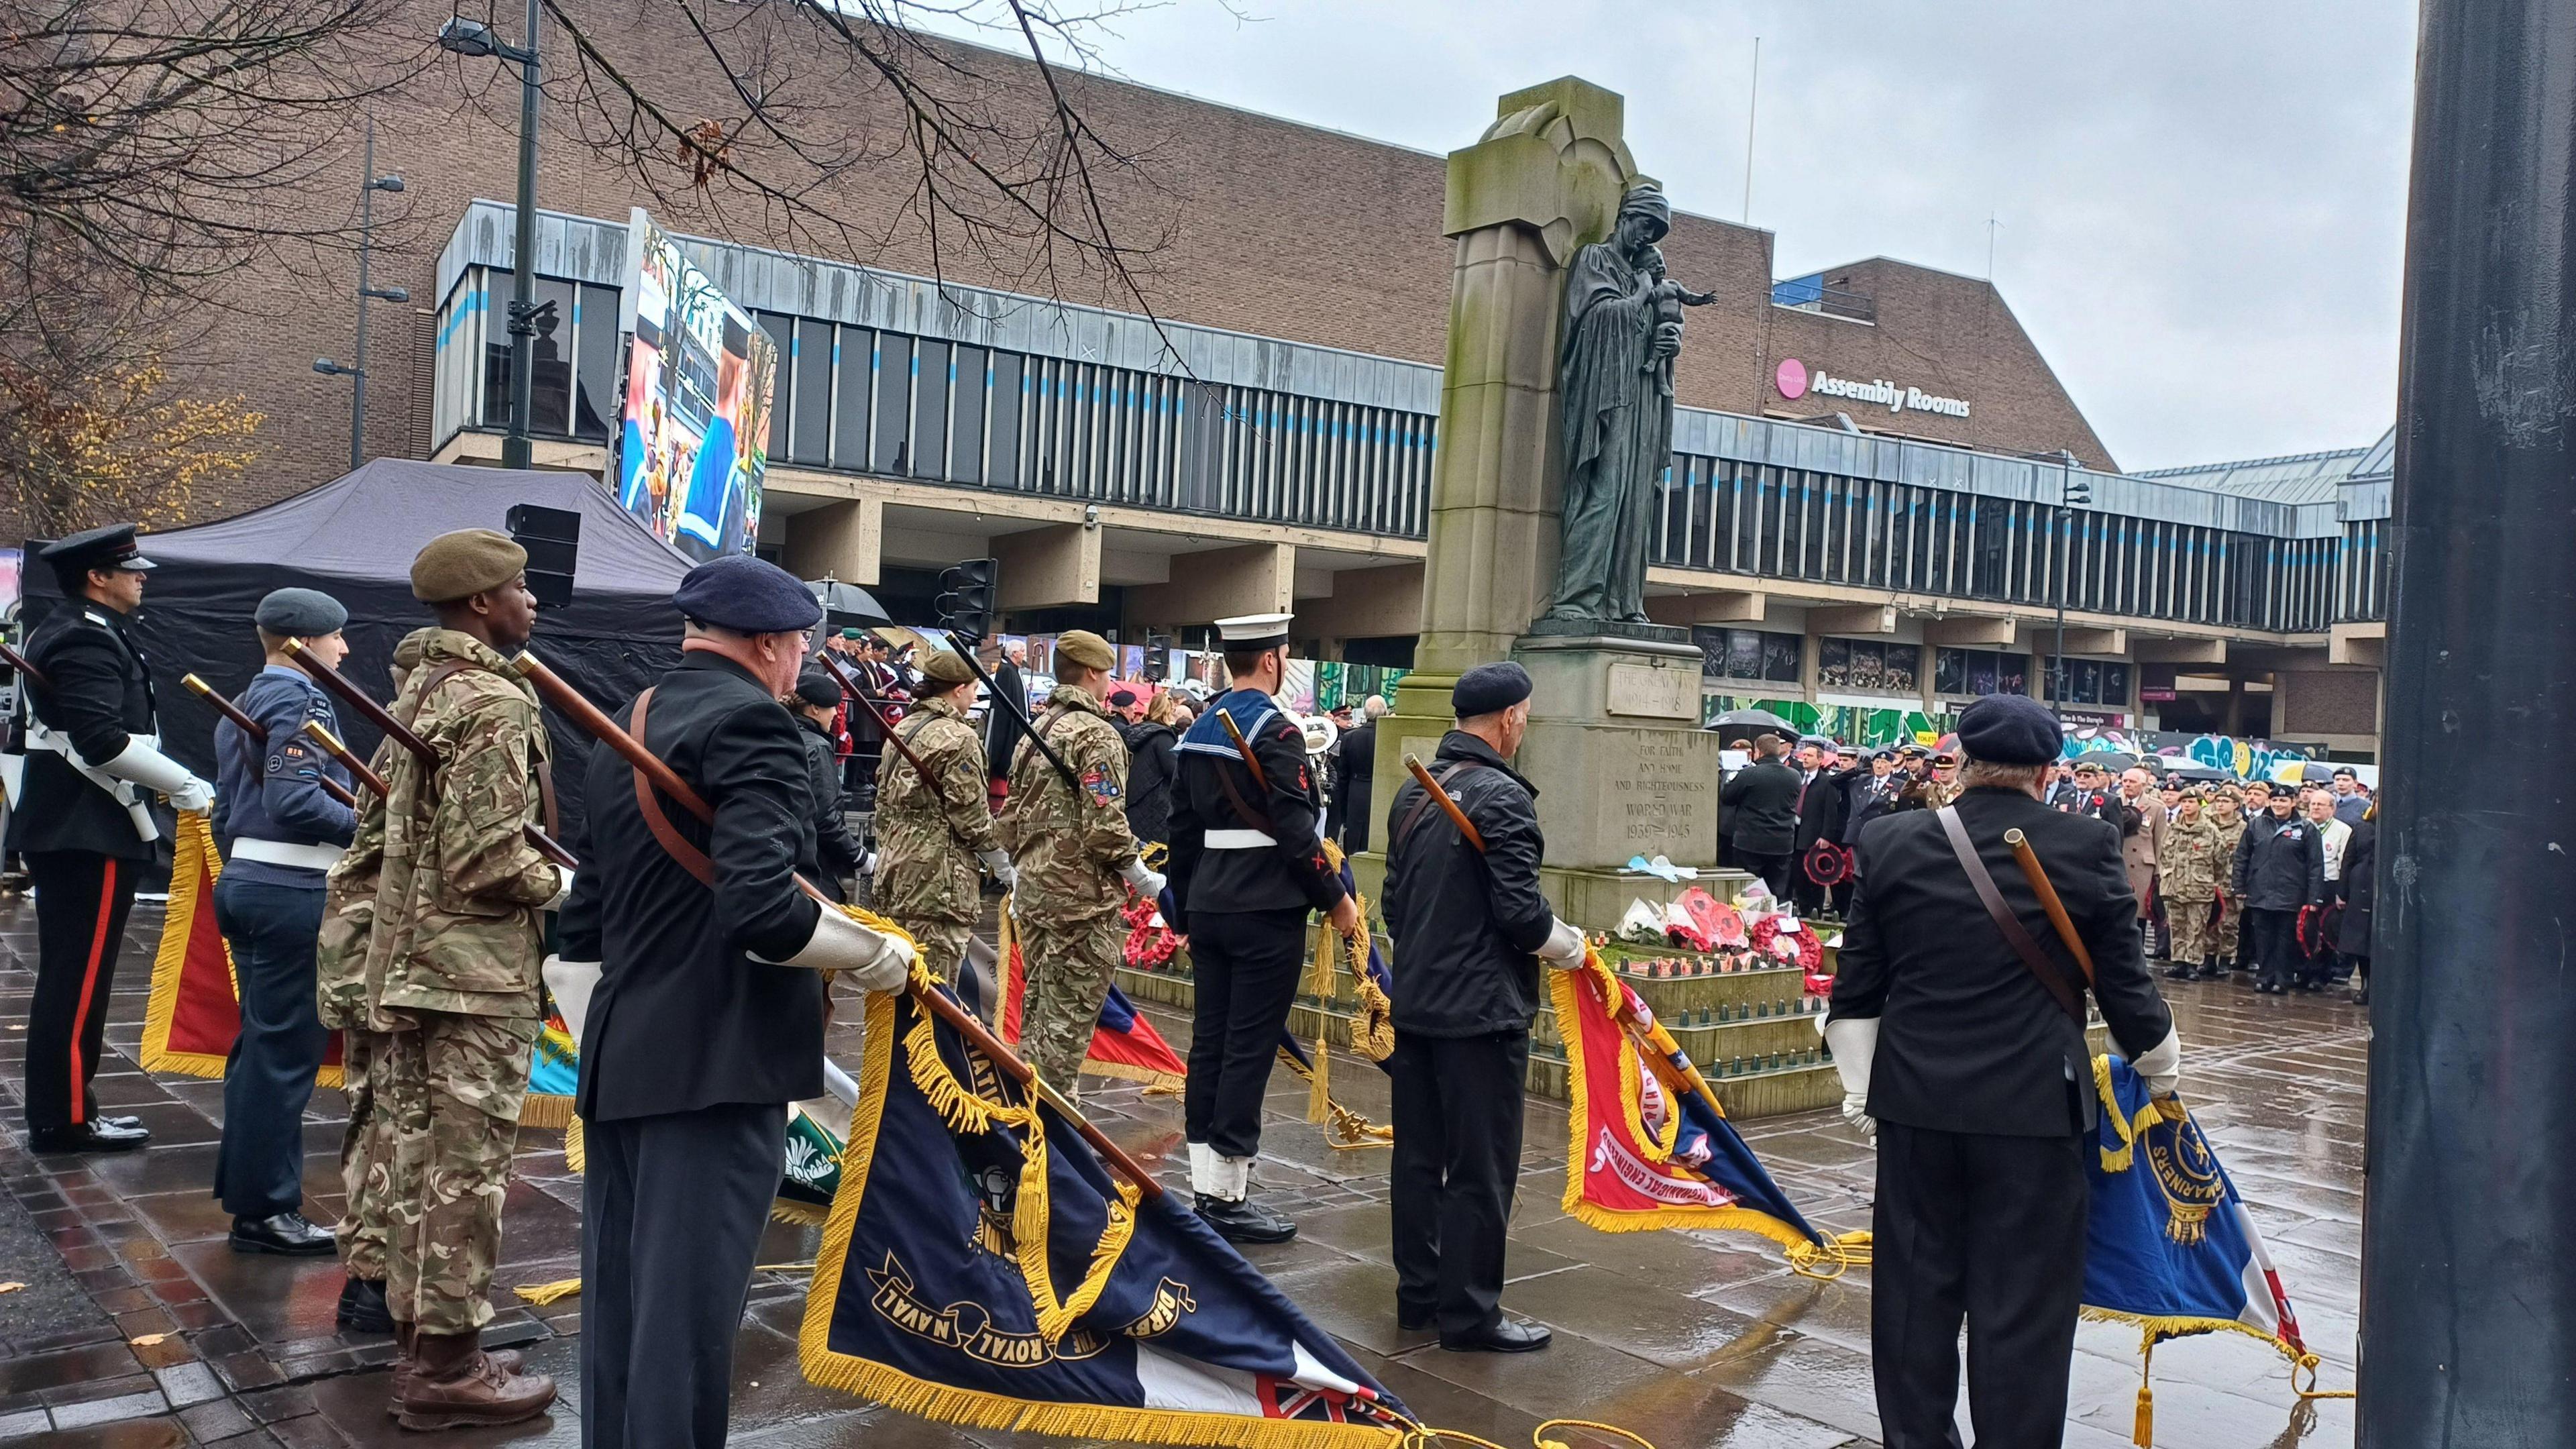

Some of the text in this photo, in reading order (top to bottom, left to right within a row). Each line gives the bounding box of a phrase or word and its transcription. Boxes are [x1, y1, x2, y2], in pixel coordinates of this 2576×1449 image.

[1811, 370, 1970, 417] Assembly Rooms
[1618, 672, 1637, 687] THE
[1640, 745, 1655, 756] FOR
[1639, 763, 1684, 774] AND HOME
[1615, 780, 1705, 792] AND RIGHTEOUSNESS
[1626, 804, 1692, 817] WORLD WAR
[2153, 1146, 2222, 1198] BMARINERS
[883, 1288, 950, 1340] NAVAL
[1122, 1289, 1176, 1337] DERBY
[979, 1332, 1042, 1362] ROYAL
